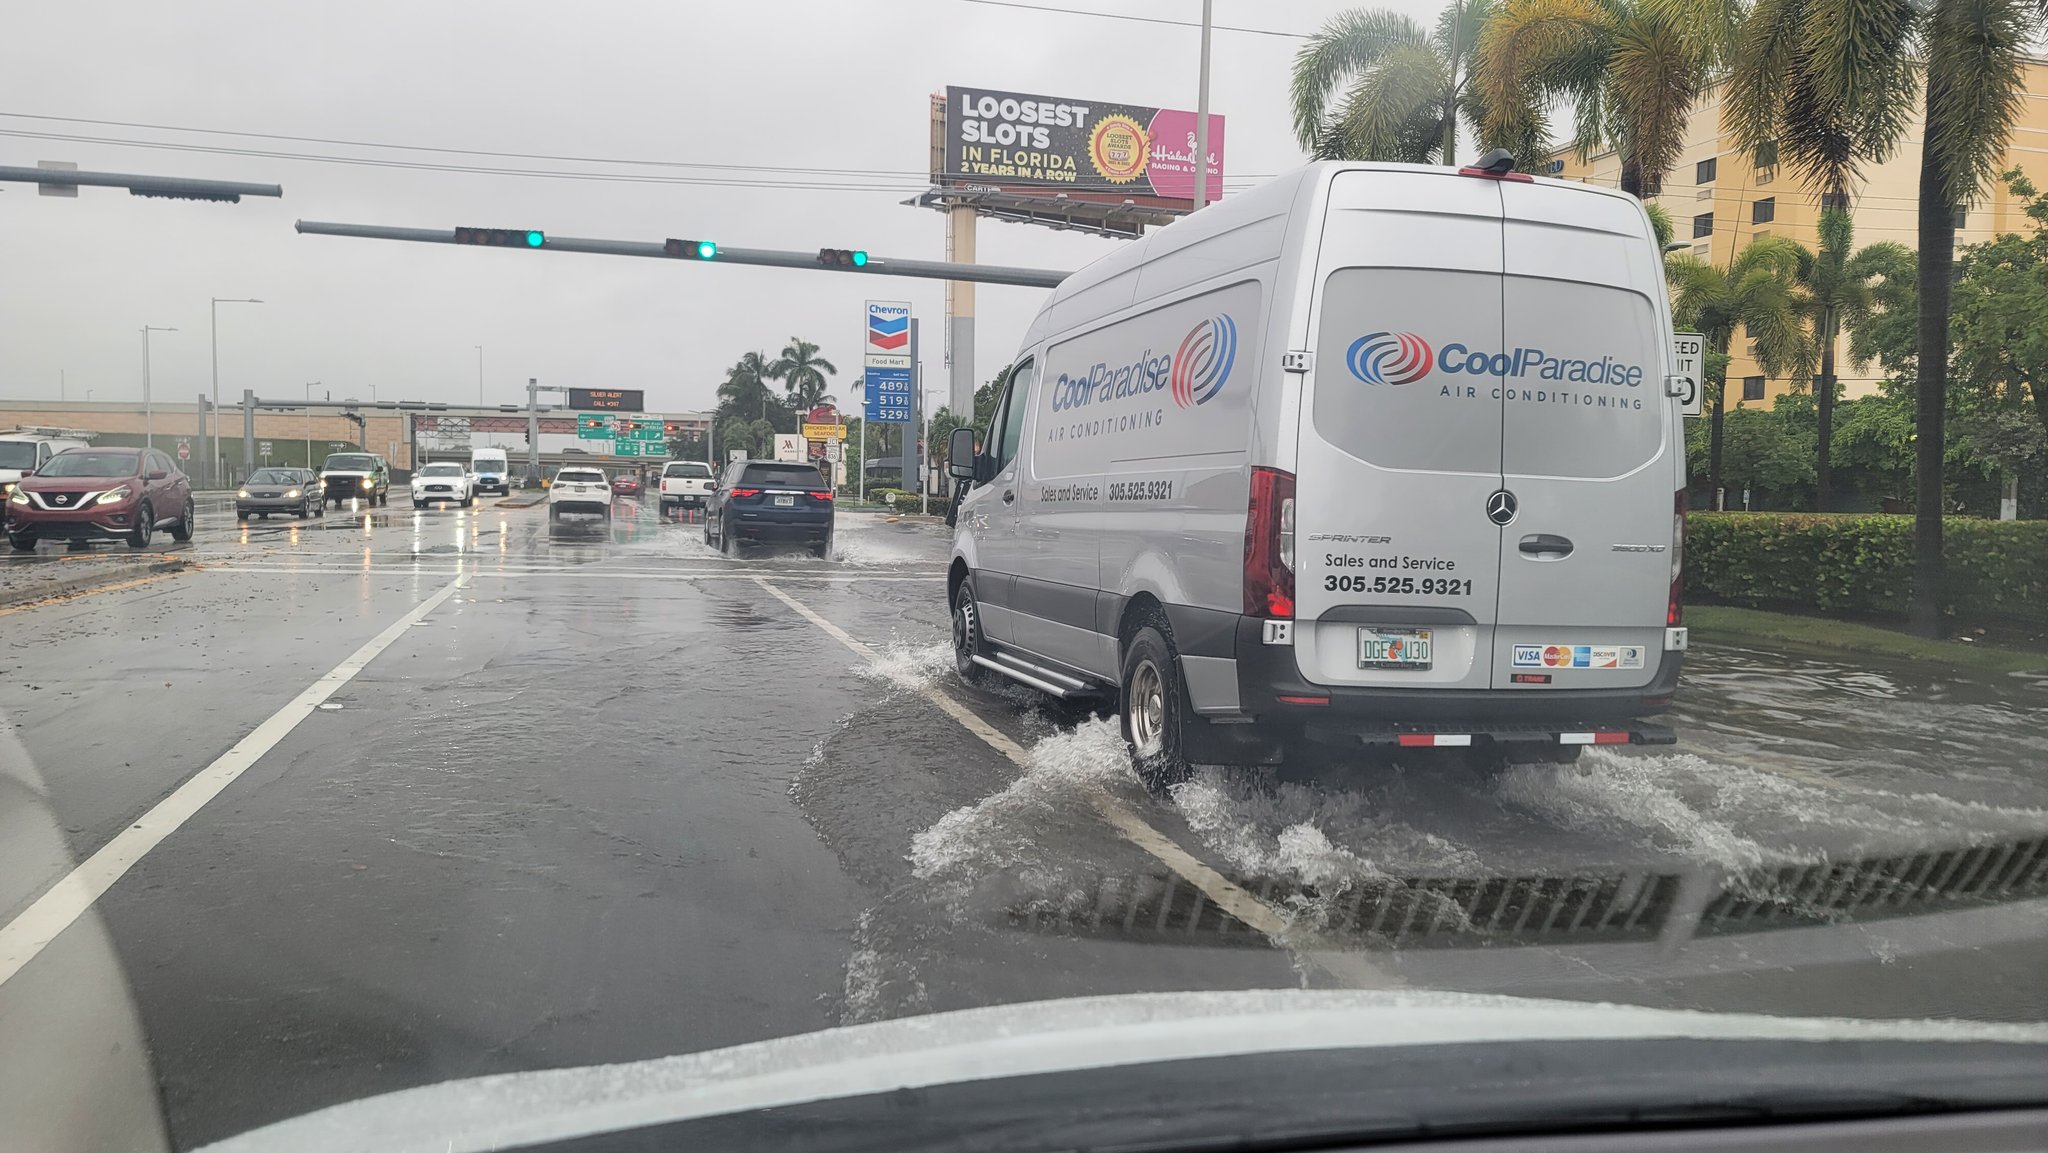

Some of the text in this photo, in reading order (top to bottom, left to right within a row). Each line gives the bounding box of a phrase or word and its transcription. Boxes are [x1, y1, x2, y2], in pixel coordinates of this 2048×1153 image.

[962, 94, 1090, 129] LOOSEST
[961, 119, 1051, 149] SLOTS
[962, 145, 1077, 171] IN FLORIDA
[1151, 163, 1181, 171] RACING
[960, 161, 1078, 182] 2 YEARS IN A ROW
[869, 304, 909, 315] Chevron
[1438, 343, 1643, 387] CoolParadise
[1052, 348, 1172, 413] CoolParadise
[1440, 385, 1642, 410] AIR CONDITIONING
[1047, 409, 1163, 443] AIR CONDITIONING
[1041, 483, 1098, 503] Sales and Service
[1109, 480, 1173, 501] 305.525.9321
[1308, 532, 1392, 544] SPRINTER
[1325, 553, 1456, 571] Sales and Service
[1324, 575, 1473, 596] 305.525.9321
[1364, 641, 1388, 659] DGE
[1517, 650, 1540, 661] VISA
